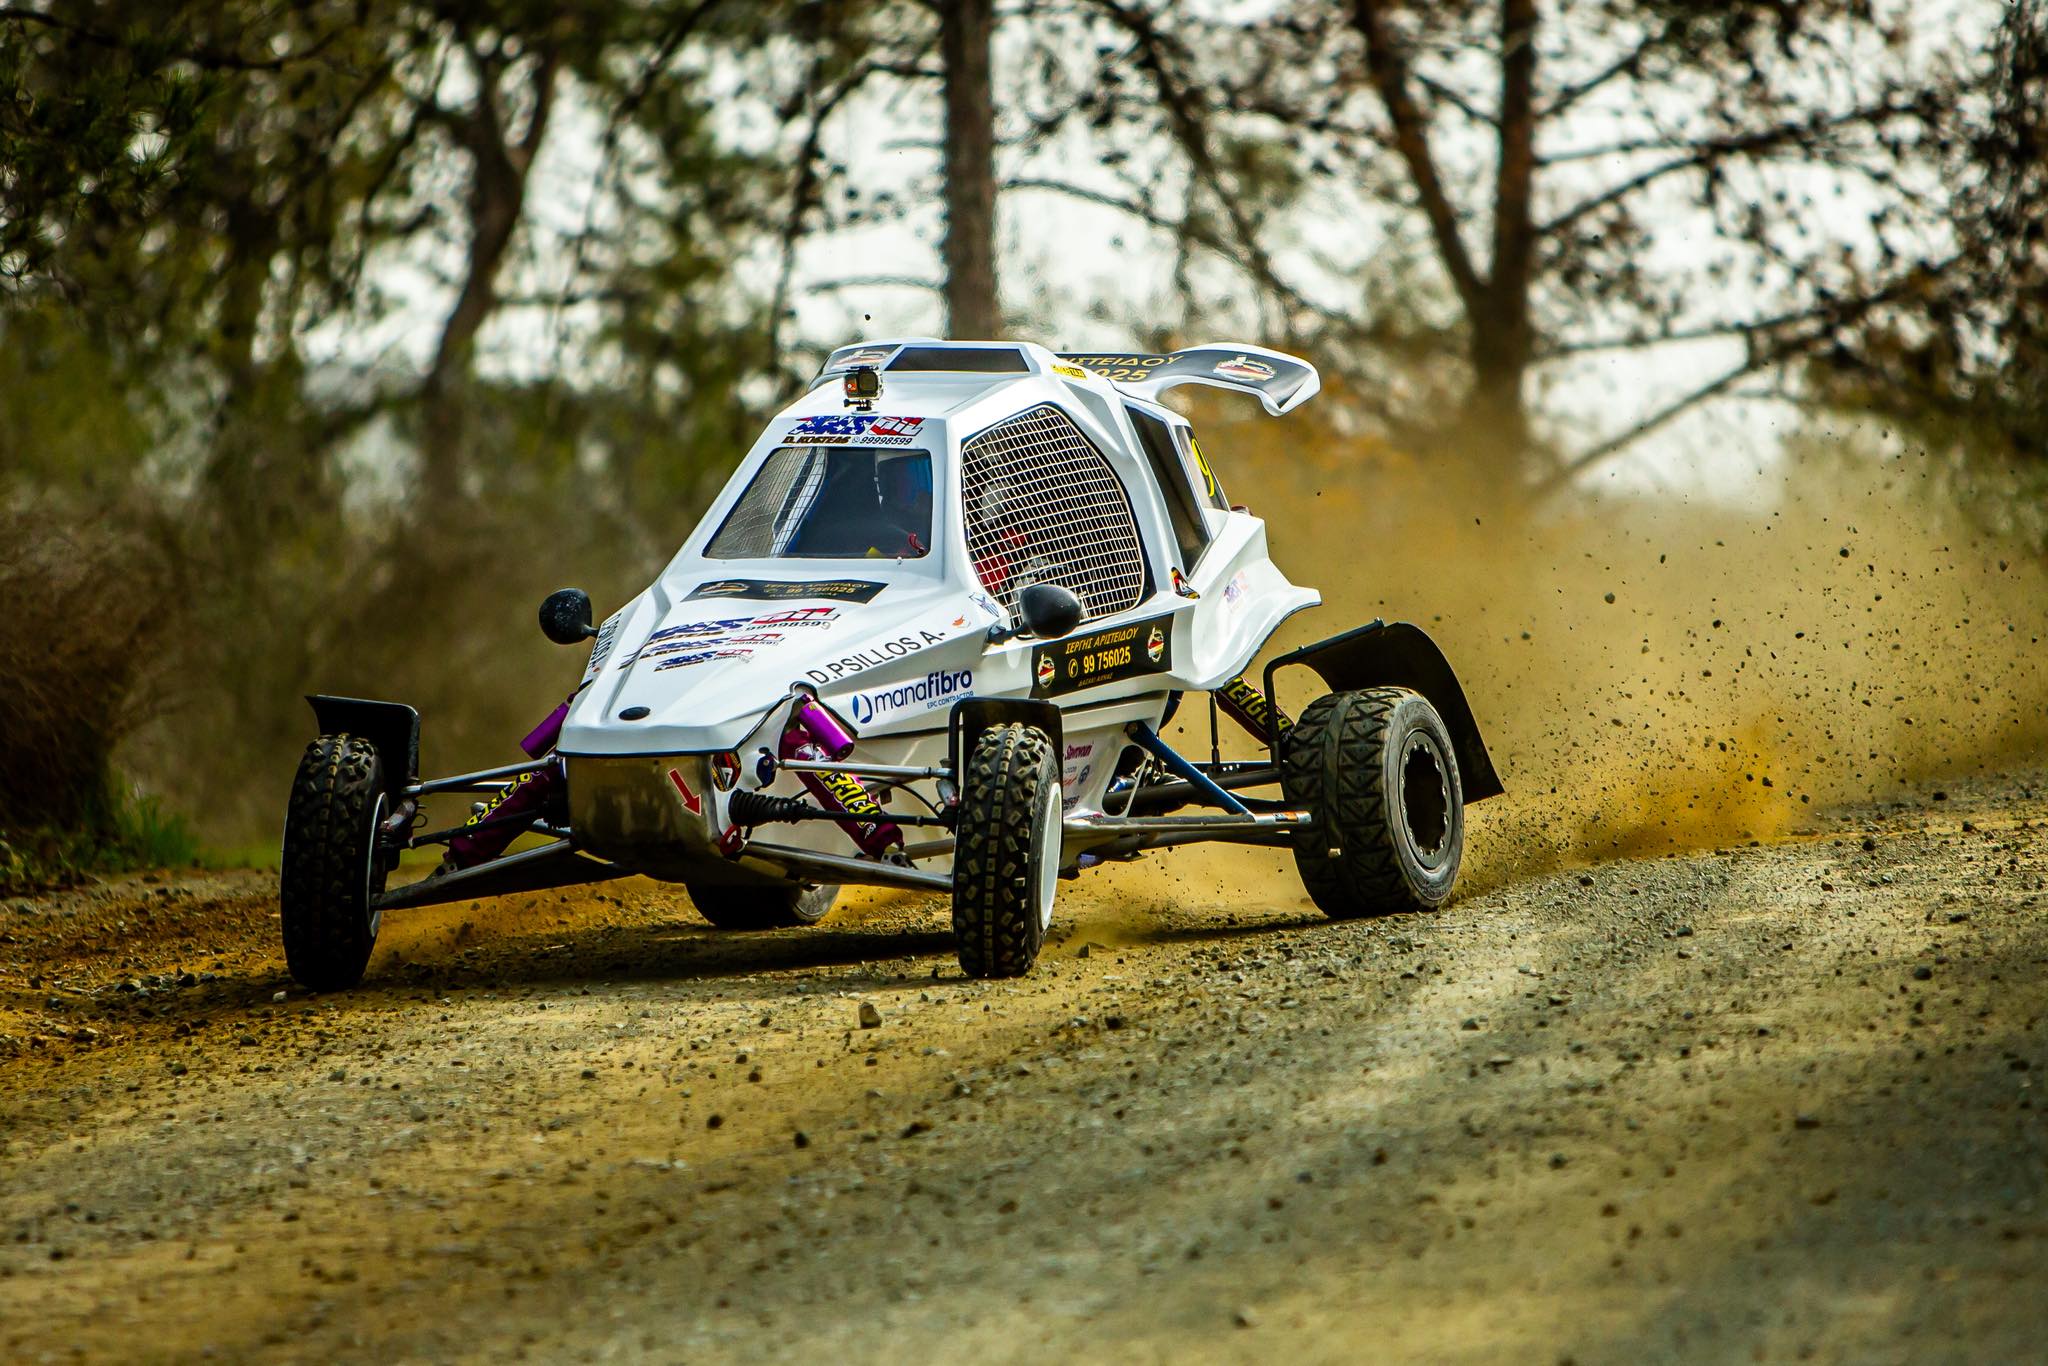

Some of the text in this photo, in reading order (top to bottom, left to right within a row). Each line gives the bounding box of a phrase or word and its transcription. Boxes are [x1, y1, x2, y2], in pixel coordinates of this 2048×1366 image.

[1064, 355, 1184, 367] ΙΣΤΕΙΔΟΥ
[1093, 368, 1152, 381] 025
[859, 436, 913, 446] 99998599
[1191, 438, 1215, 497] 9
[1065, 626, 1140, 655] ΣΕΡΓΗΣ ΑΡΙΣΤΕΙΔΟΥ
[806, 636, 922, 685] D.PSILLOS
[1083, 645, 1131, 674] 99 756025
[874, 669, 973, 714] manafibro
